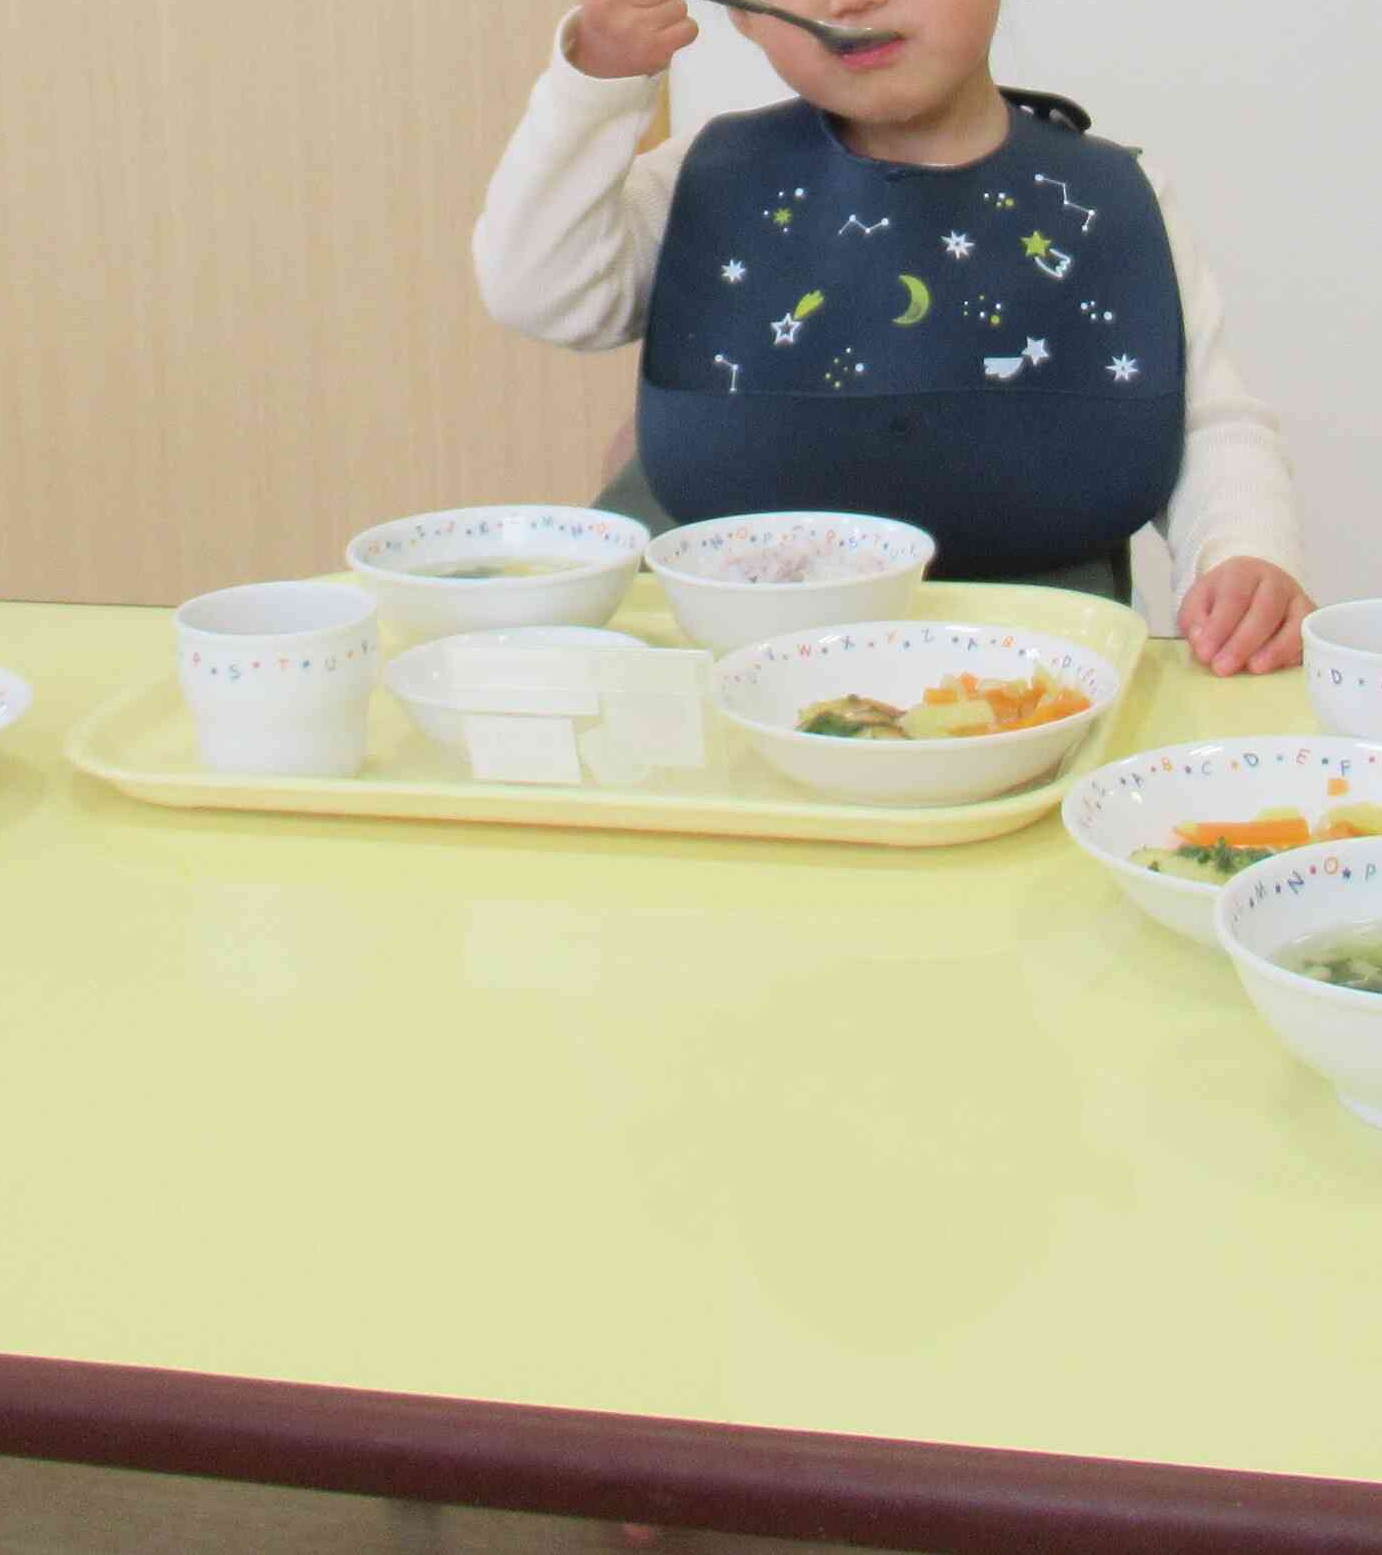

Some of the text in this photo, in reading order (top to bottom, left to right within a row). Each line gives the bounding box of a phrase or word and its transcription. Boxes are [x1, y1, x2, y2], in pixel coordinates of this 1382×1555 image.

[1330, 668, 1343, 685] D
[1243, 751, 1260, 768] D
[1296, 747, 1312, 766] E
[1340, 758, 1352, 777] F
[1288, 870, 1305, 895] N
[1323, 856, 1339, 876] O
[1365, 862, 1377, 882] P
